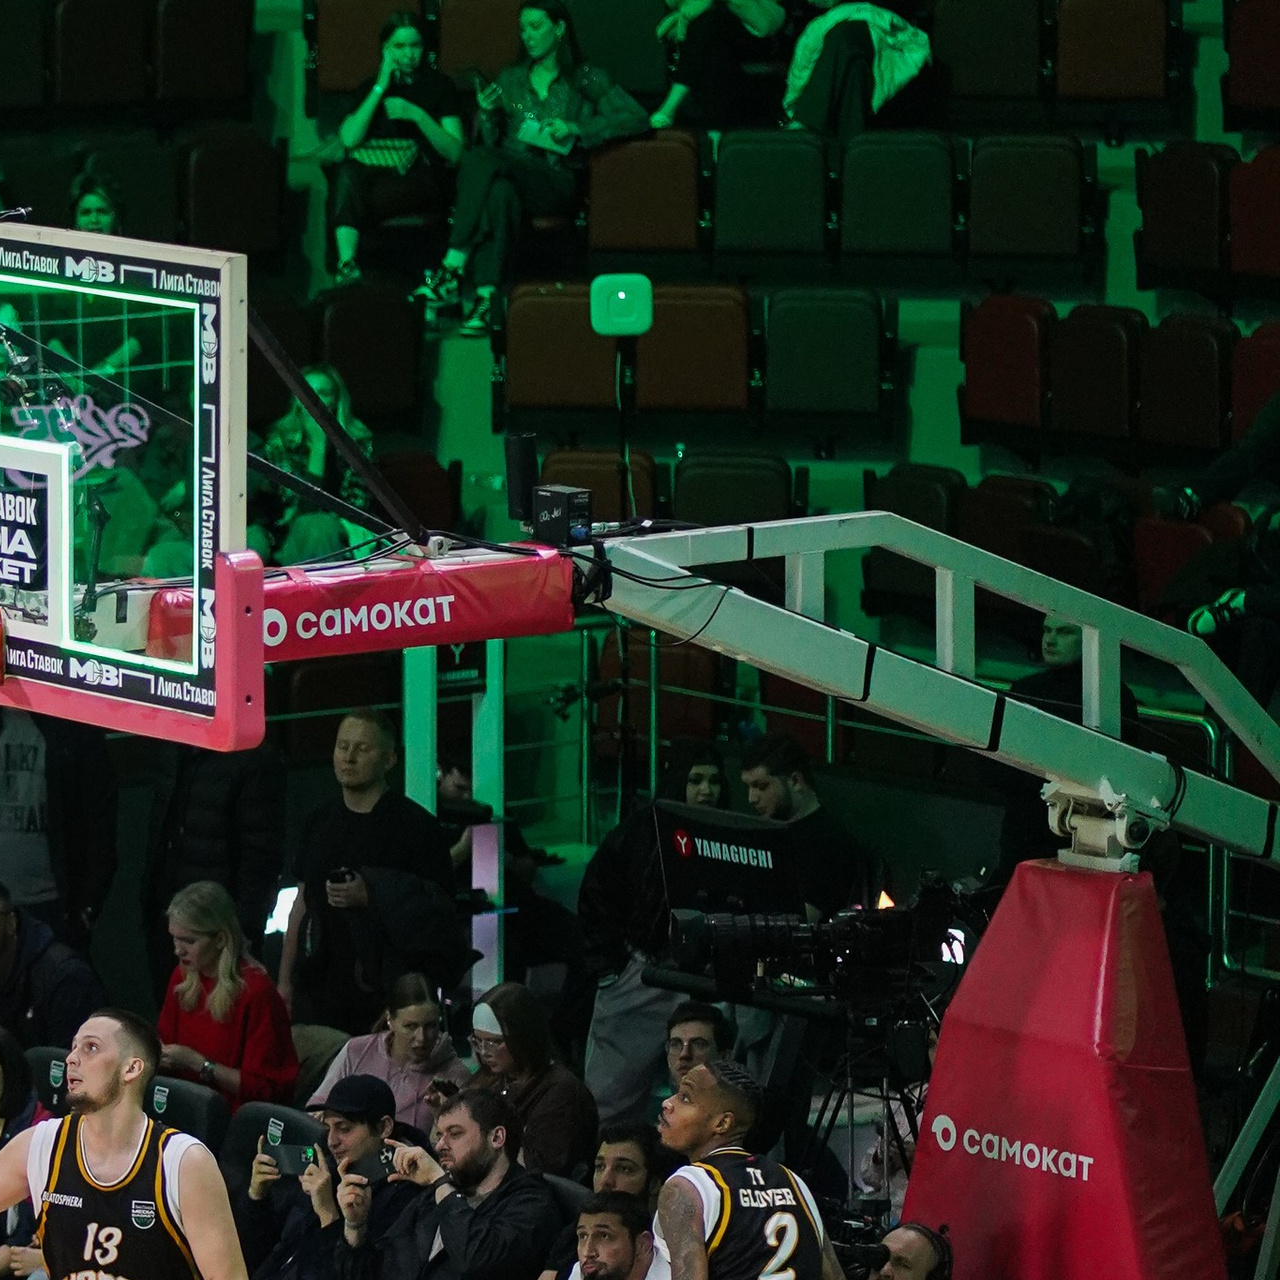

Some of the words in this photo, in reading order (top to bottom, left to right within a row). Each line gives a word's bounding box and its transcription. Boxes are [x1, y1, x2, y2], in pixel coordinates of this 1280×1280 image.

[296, 594, 455, 639] самокат
[694, 837, 773, 869] YAMAGUCHI
[962, 1128, 1094, 1182] самокат
[738, 1187, 797, 1209] GLOVER
[83, 1222, 123, 1266] 13
